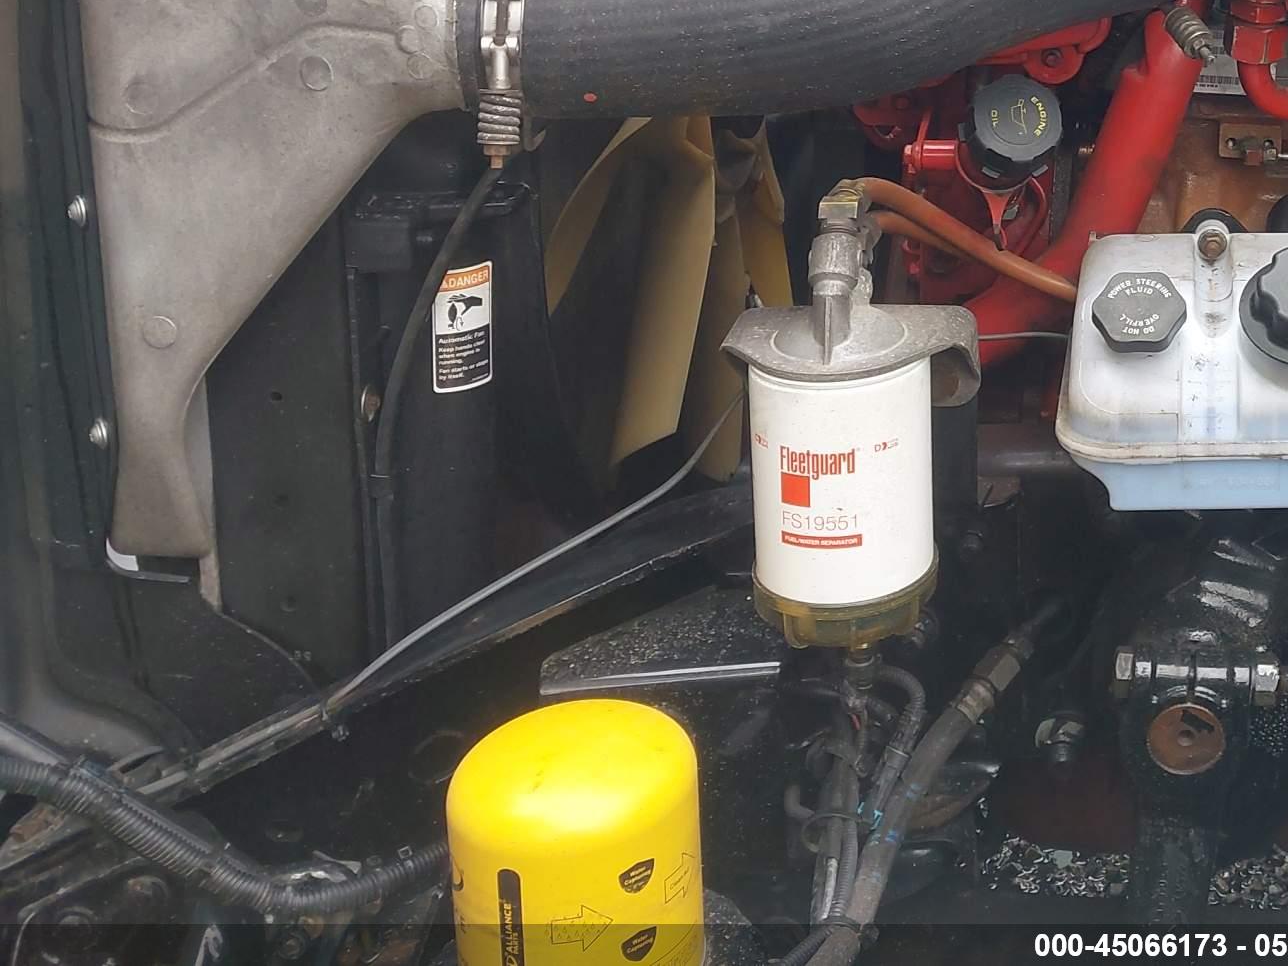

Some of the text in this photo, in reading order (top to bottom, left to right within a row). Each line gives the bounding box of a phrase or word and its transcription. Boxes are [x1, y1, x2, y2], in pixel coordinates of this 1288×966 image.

[991, 109, 999, 127] OIL
[1030, 96, 1047, 136] ENGINE
[448, 270, 489, 287] DANGER
[1107, 278, 1172, 299] POWER STEERING
[1124, 286, 1153, 296] FLUID
[1120, 313, 1160, 327] OVERFILL
[1122, 326, 1155, 335] DO NOT
[780, 445, 855, 480] Fleetguard
[782, 511, 858, 531] FS19551
[503, 902, 514, 953] ALLIANCE
